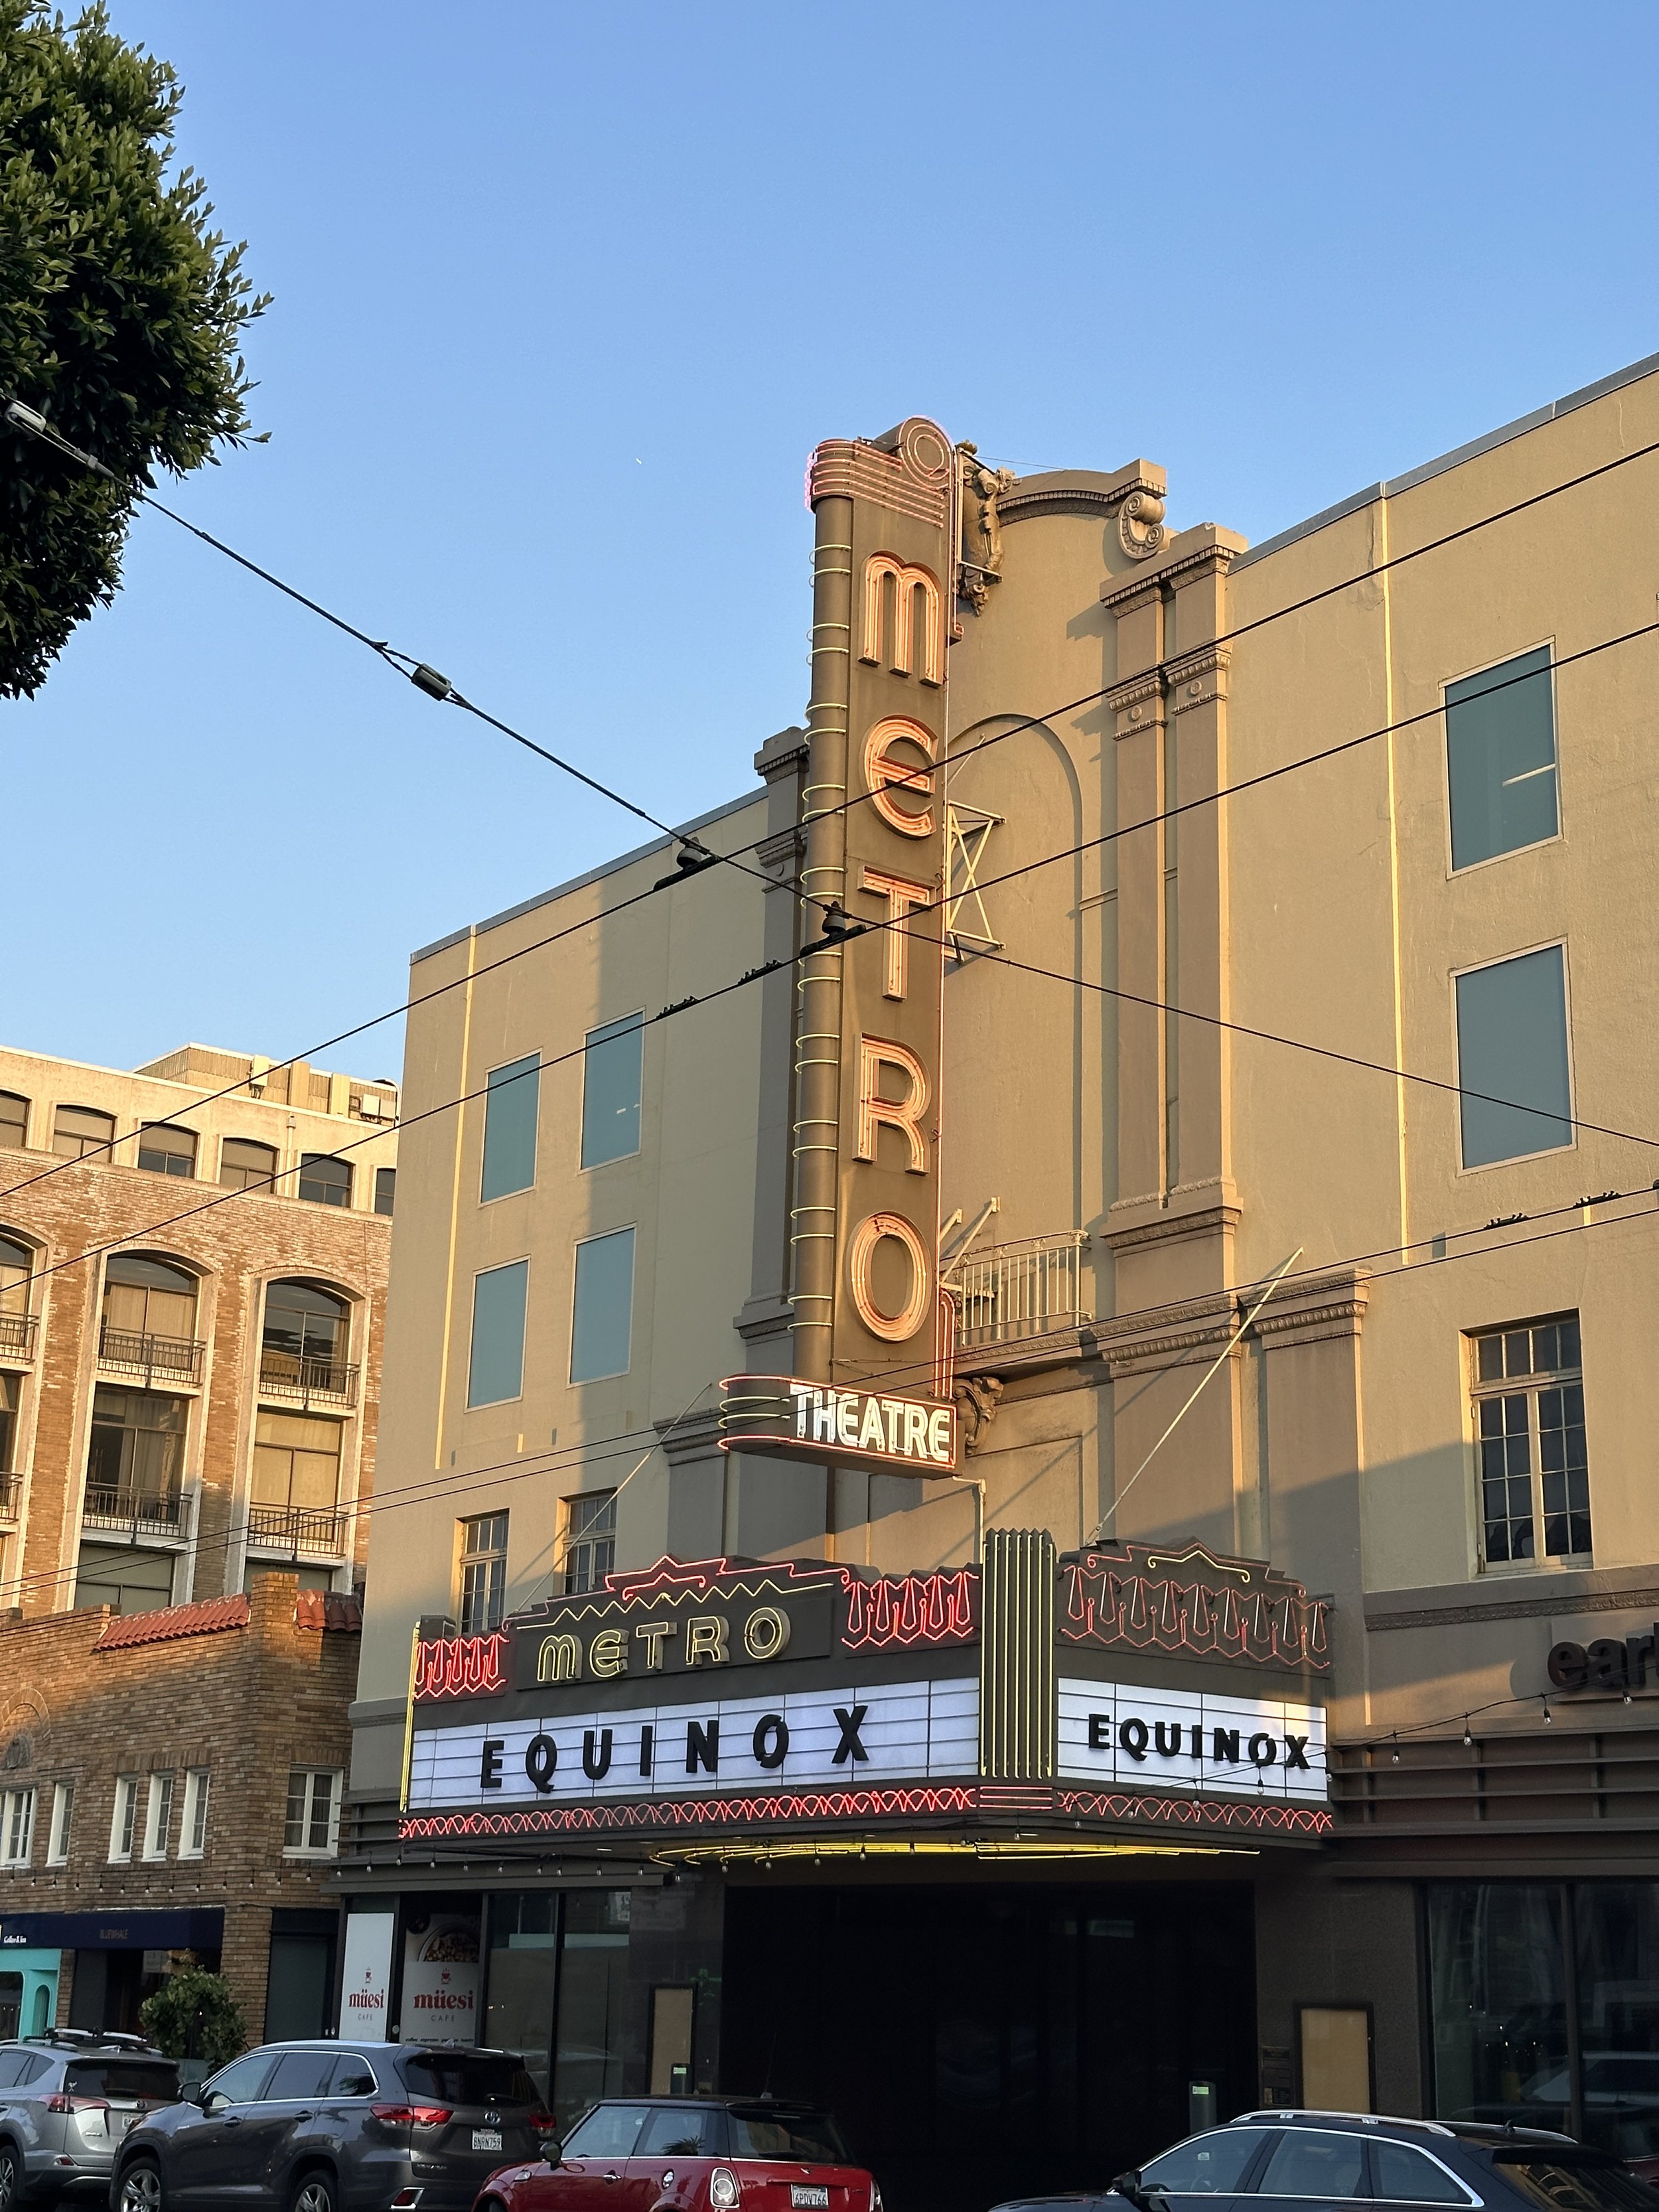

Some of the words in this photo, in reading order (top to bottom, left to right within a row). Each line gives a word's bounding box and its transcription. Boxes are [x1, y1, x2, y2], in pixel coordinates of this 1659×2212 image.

[846, 550, 944, 1342] METRO
[790, 1383, 950, 1461] THEATRE
[536, 1607, 790, 1682] METRO
[1547, 1621, 1659, 1691] ear
[481, 1704, 870, 1794] EQUINOX
[1088, 1713, 1311, 1770] EQUINOX
[348, 1988, 384, 2009] müesi
[413, 1990, 474, 2010] müesi
[431, 2014, 456, 2022] CAFE
[795, 2193, 826, 2205] 6PDV766
